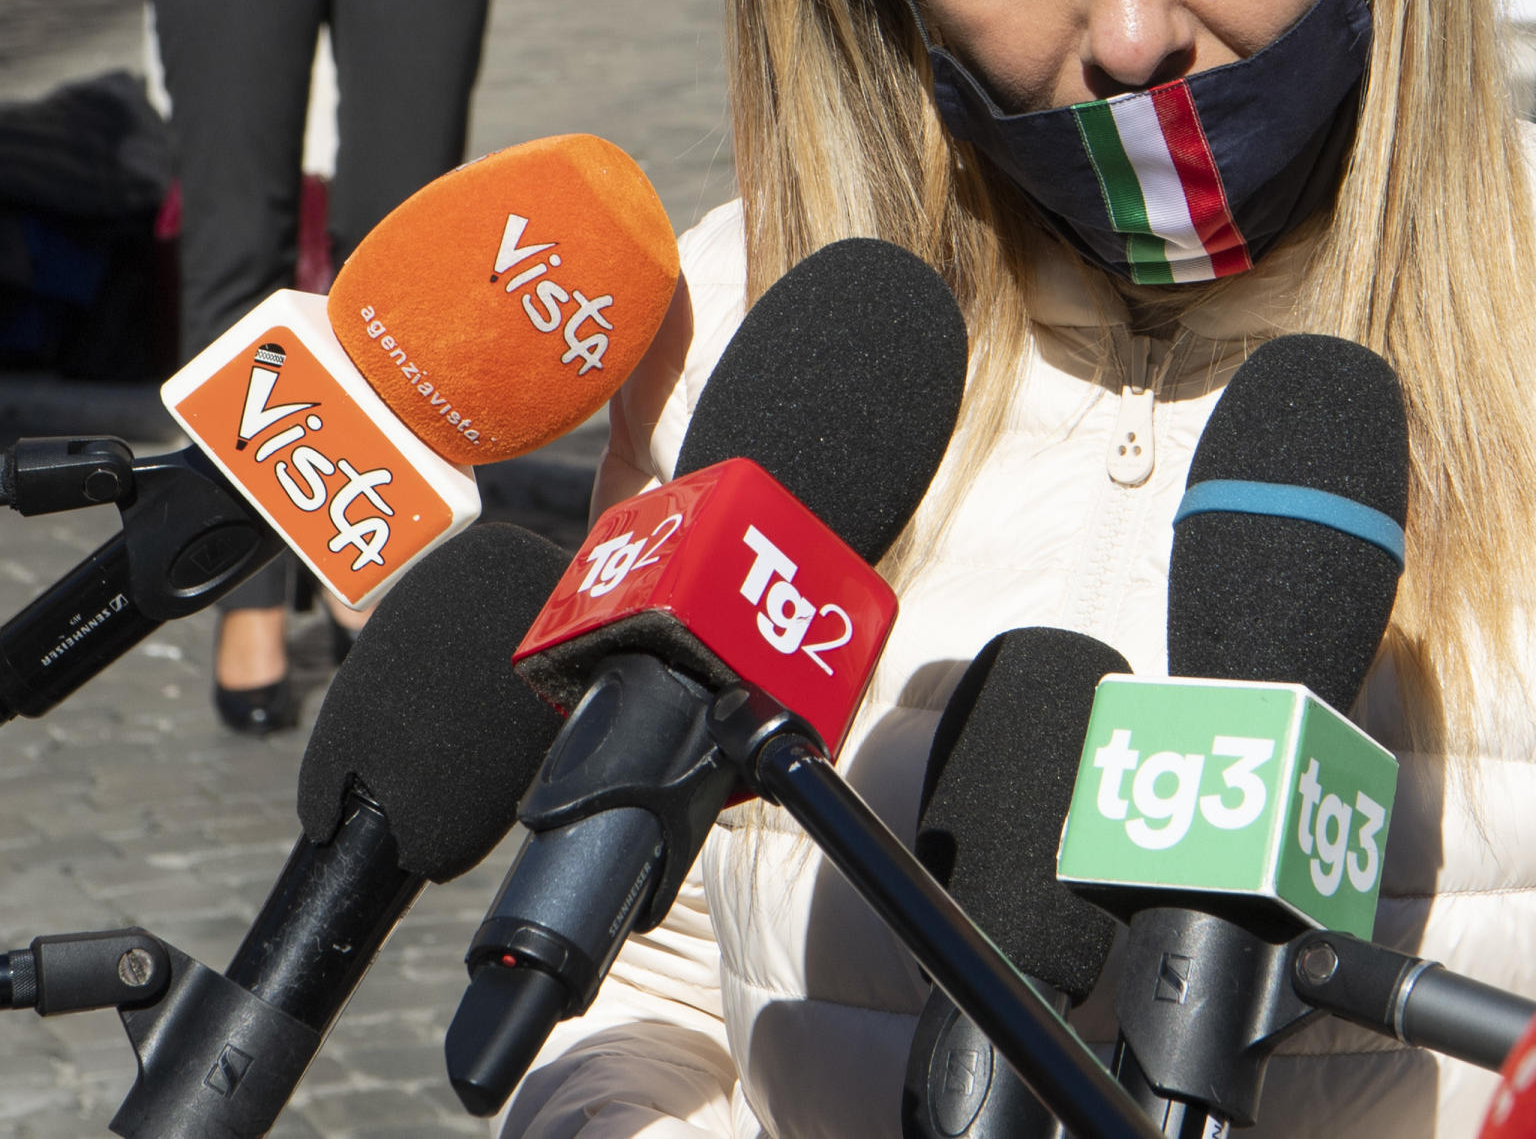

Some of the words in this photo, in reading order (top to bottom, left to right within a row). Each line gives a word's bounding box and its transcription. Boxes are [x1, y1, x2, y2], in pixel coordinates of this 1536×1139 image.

[577, 513, 684, 599] Tg2
[739, 524, 854, 677] Tg2
[40, 608, 112, 667] SENNHEISER
[1093, 728, 1276, 851] tg3
[1297, 756, 1387, 898] tg3
[608, 860, 653, 939] SENNHEISER
